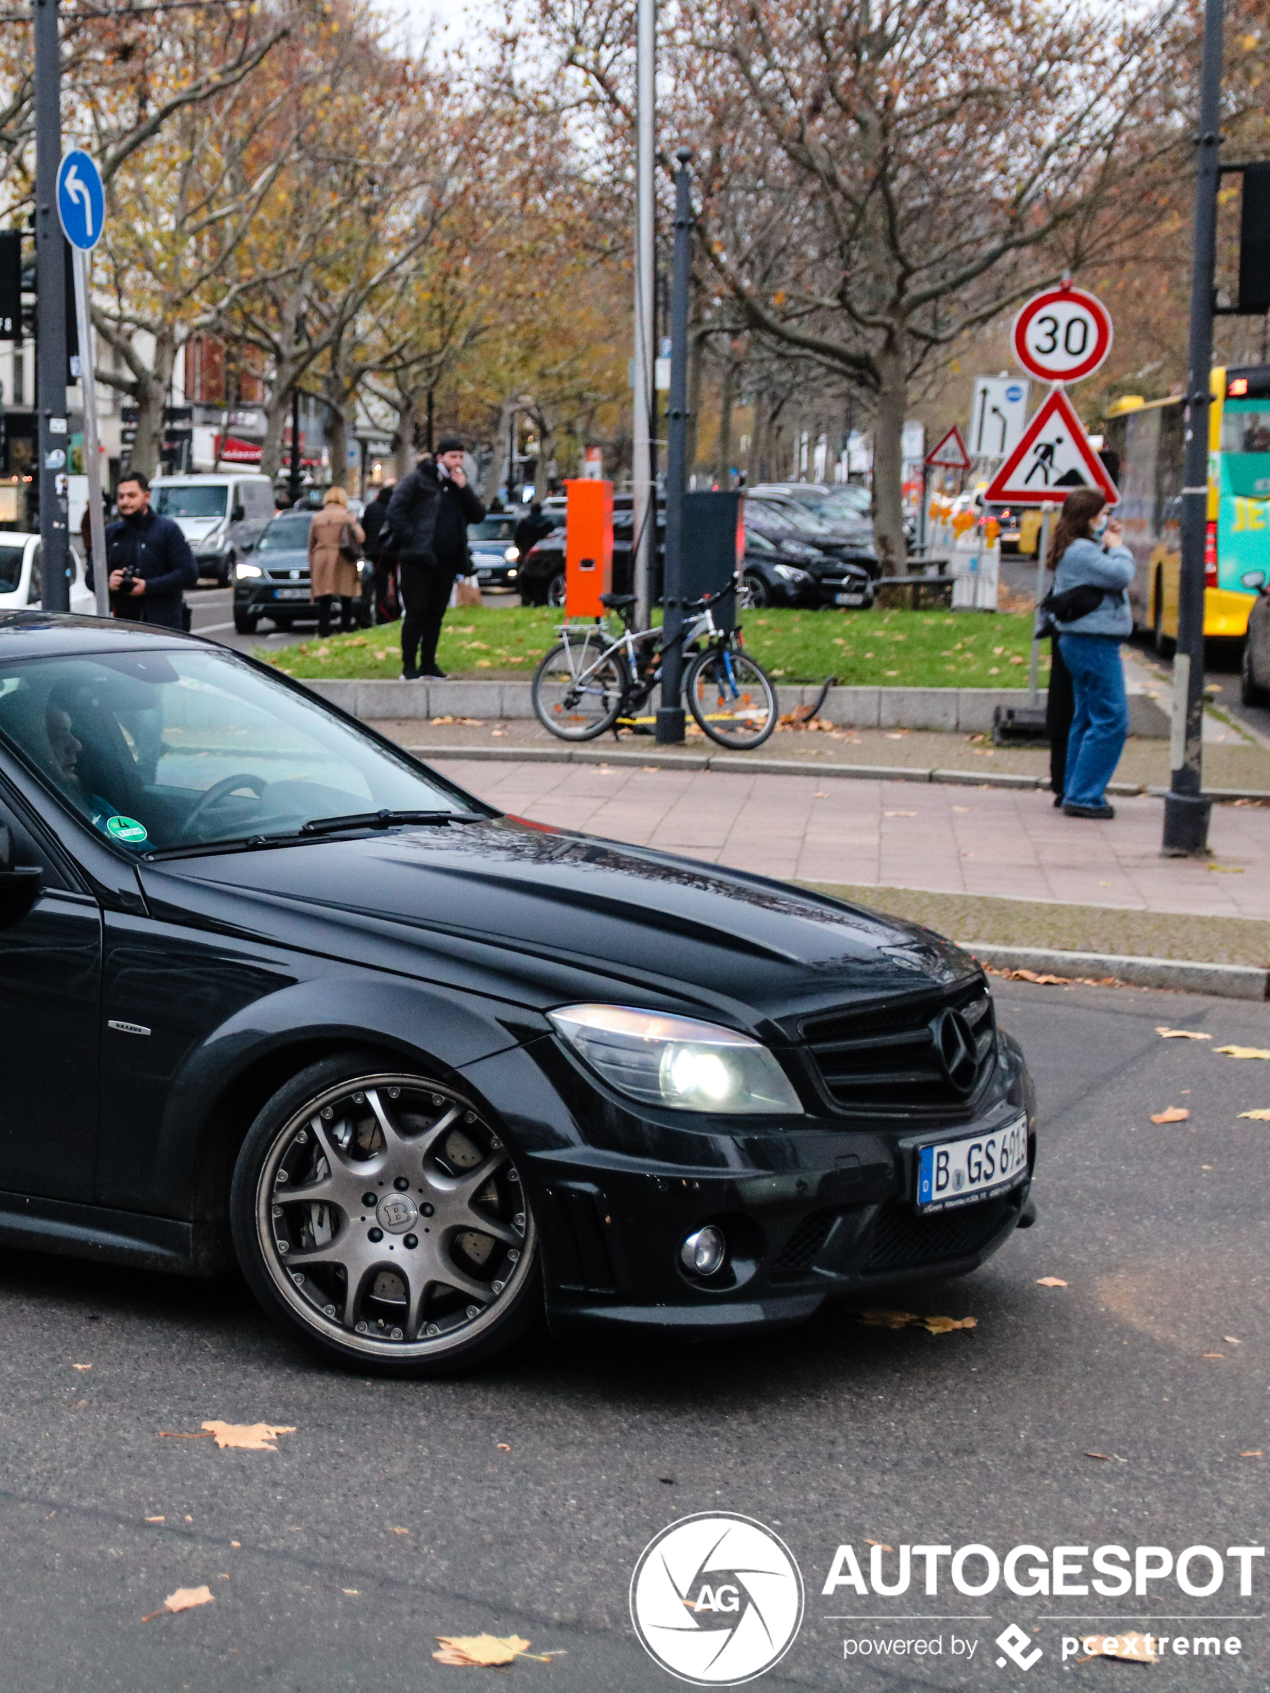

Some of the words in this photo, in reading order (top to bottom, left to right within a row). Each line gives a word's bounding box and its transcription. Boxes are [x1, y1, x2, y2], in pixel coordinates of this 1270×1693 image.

[1035, 316, 1089, 355] 30
[1233, 497, 1267, 532] JE
[935, 1150, 950, 1192] B
[967, 1139, 996, 1184] GS
